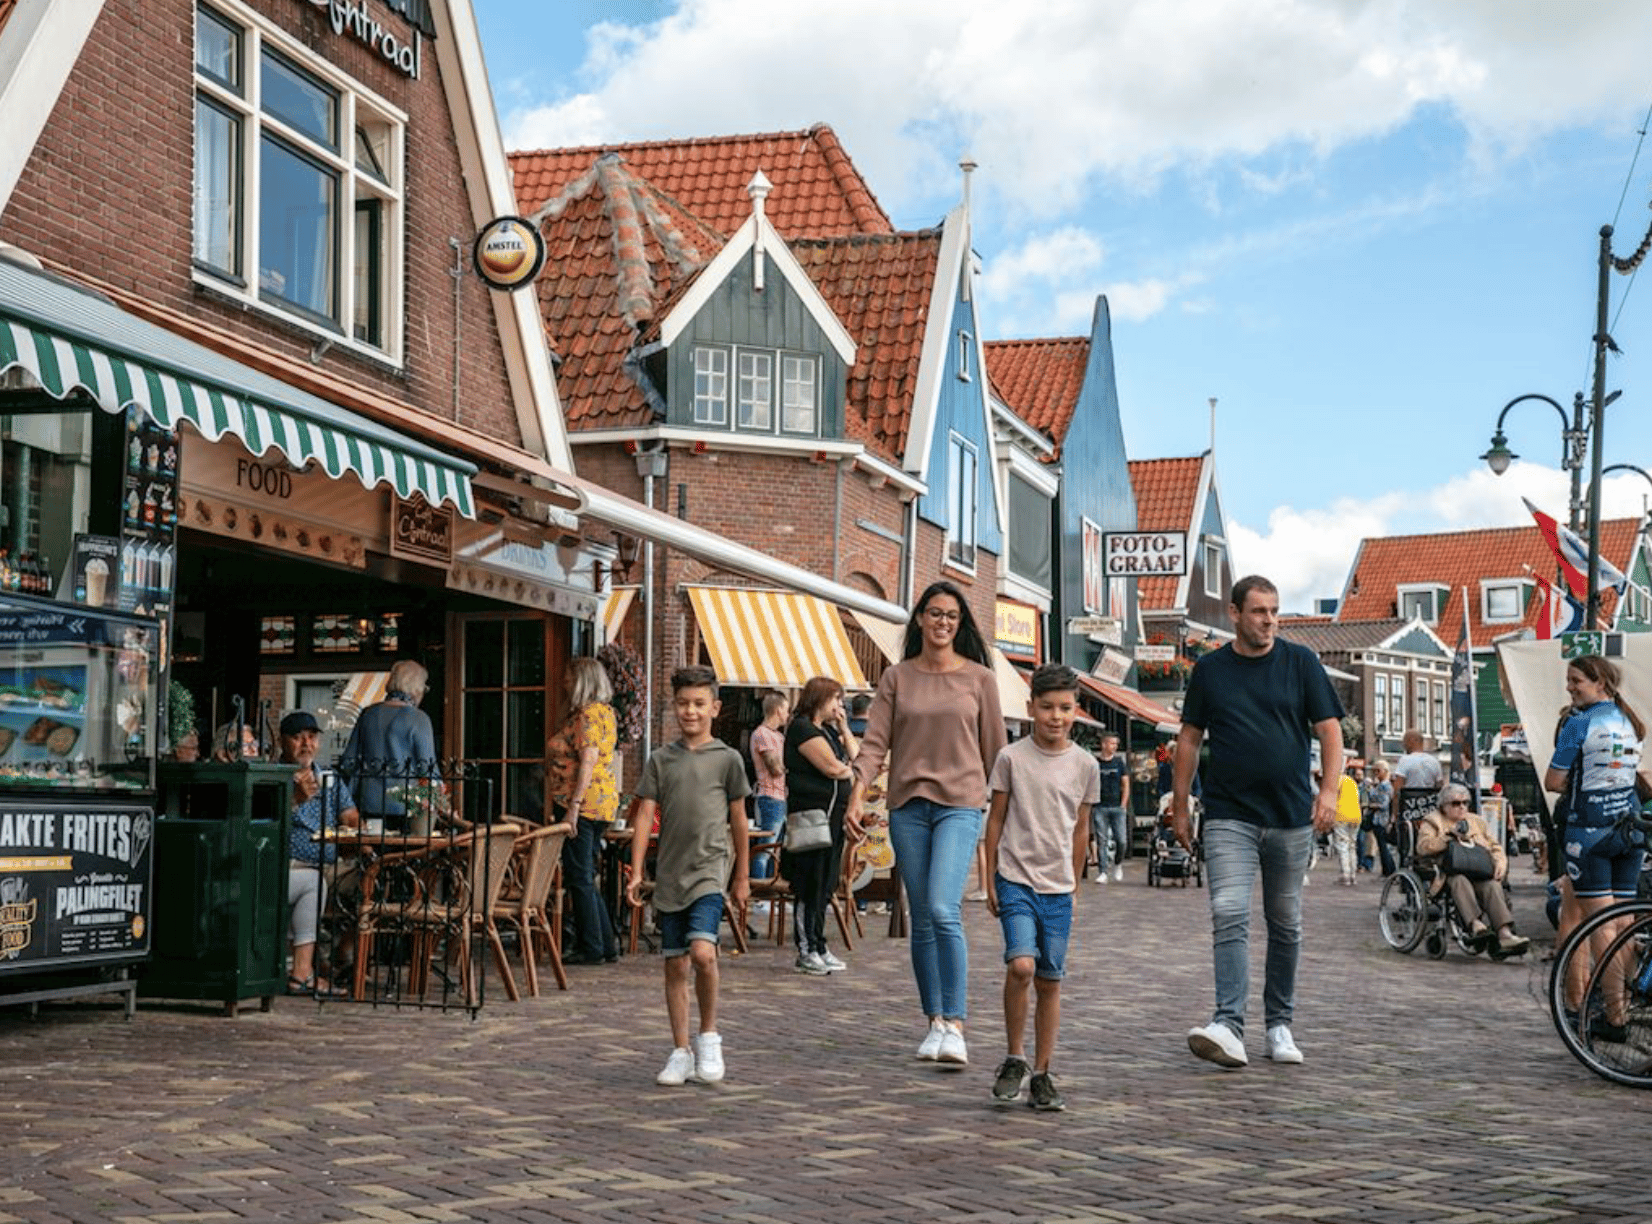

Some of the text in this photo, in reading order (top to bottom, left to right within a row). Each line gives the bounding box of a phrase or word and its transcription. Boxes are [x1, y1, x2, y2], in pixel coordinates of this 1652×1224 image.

[308, 0, 421, 81] entraal
[487, 240, 522, 251] AMSTEL
[236, 458, 292, 499] FOOD
[1110, 535, 1176, 553] FOTO-
[1109, 554, 1181, 573] GRAAF
[63, 813, 131, 863] FRITES
[56, 884, 143, 920] PALINGFILET
